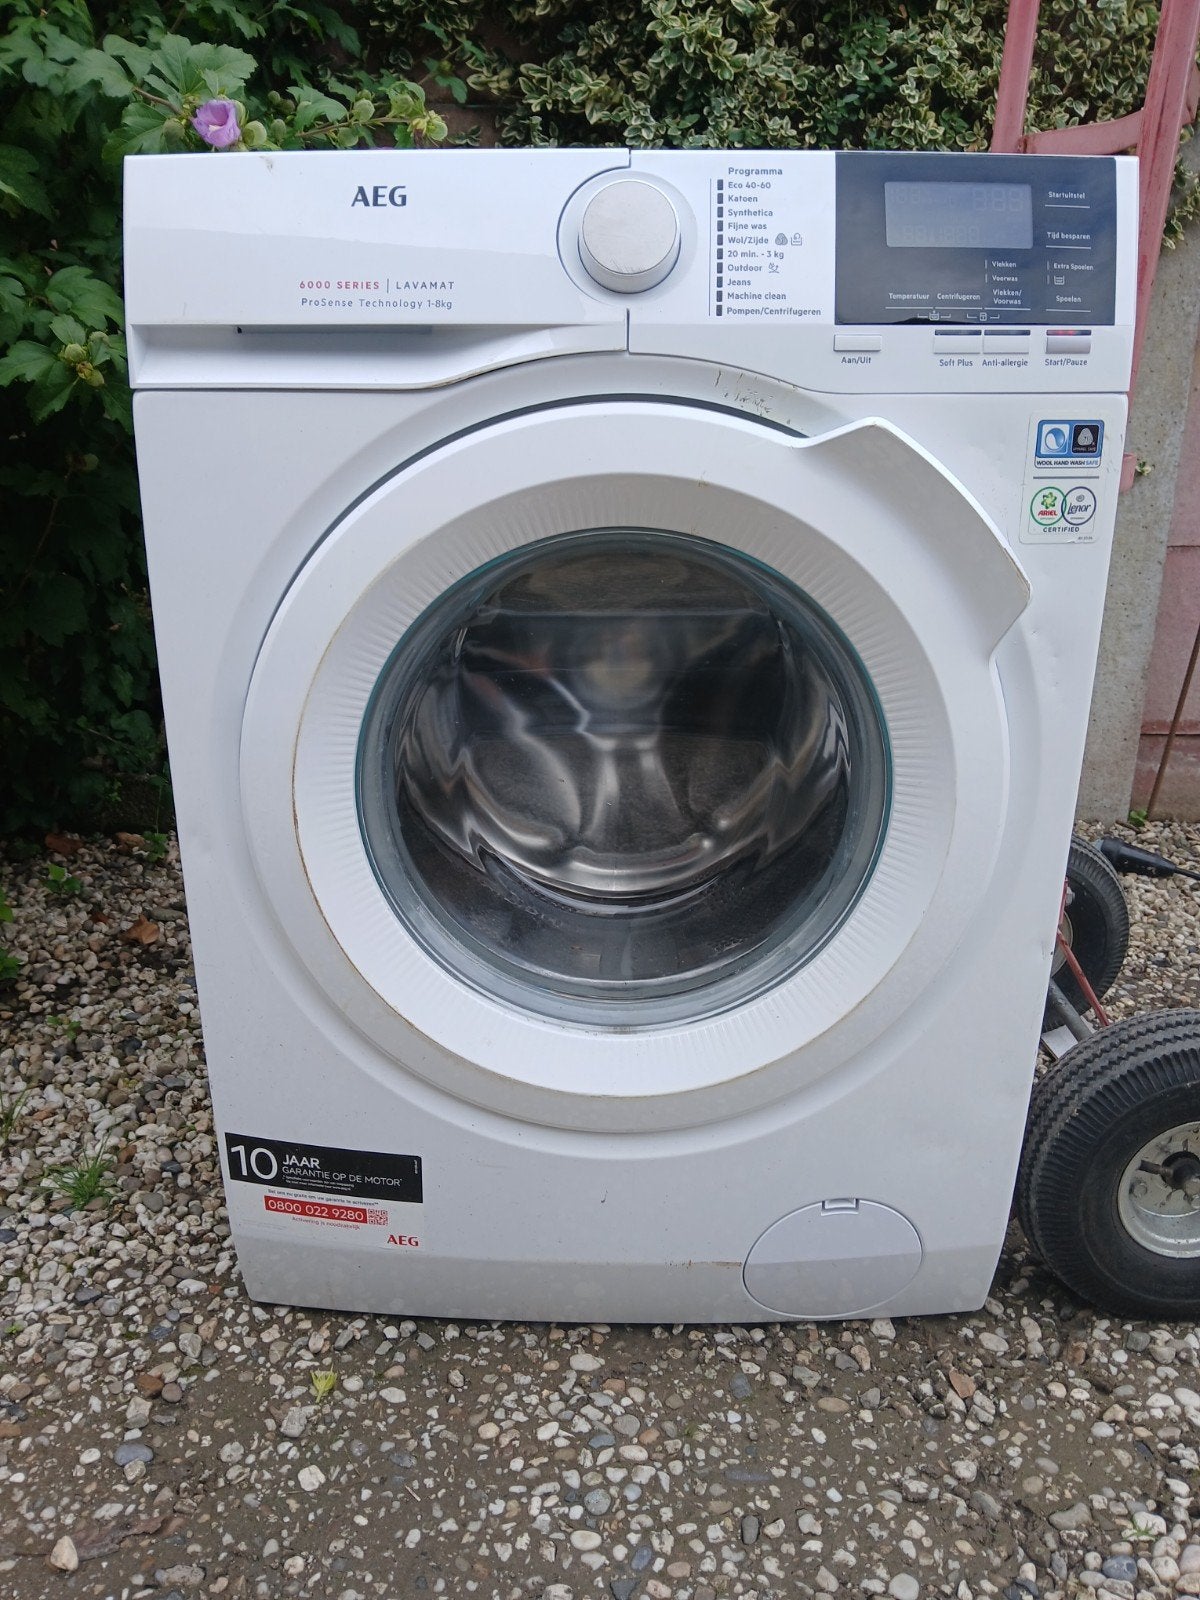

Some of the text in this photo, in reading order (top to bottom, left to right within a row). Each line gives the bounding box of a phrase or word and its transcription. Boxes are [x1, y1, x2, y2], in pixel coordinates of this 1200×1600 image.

[728, 167, 783, 177] Programma
[728, 181, 771, 189] Eco 40-60
[351, 185, 407, 207] AEG
[728, 195, 758, 203] Katoen
[1048, 190, 1086, 199] Startuitstel
[728, 209, 774, 218] Synthetica
[728, 222, 749, 231] Fijne
[728, 236, 769, 246] Wol/Zijde
[1047, 232, 1091, 241] Tijd besparen
[727, 250, 738, 258] 20
[740, 250, 759, 258] min.
[766, 250, 772, 258] 3
[774, 250, 785, 260] kg
[727, 264, 763, 272] Outdoor
[991, 260, 1017, 268] Vlekken
[1053, 262, 1094, 271] Extra Spoelen
[299, 280, 380, 290] 6000 SERIES
[396, 281, 455, 290] LAVAMAT
[727, 278, 752, 286] Jeans
[727, 292, 787, 300] Machine clean
[889, 292, 930, 301] Temperatuur
[937, 292, 981, 301] Centrifugeren
[992, 289, 1022, 297] Vlekken/
[301, 298, 453, 310] ProSense Technology 1-8kg
[993, 297, 1022, 305] Voorwas
[1055, 295, 1082, 304] Spoelen
[727, 307, 821, 317] Pompen/Centrifugeren
[841, 356, 872, 365] Aan/Uit
[939, 358, 973, 367] Soft Plus
[982, 358, 1029, 368] Anti-allergie
[1045, 358, 1088, 367] Start/Pauze
[1067, 502, 1091, 515] Lenor
[230, 1144, 278, 1180] 10
[282, 1154, 321, 1169] JAAR
[282, 1166, 331, 1180] GARANTIE
[332, 1172, 347, 1182] OP
[349, 1174, 362, 1183] DE
[268, 1199, 364, 1221] 0800 022 9280
[292, 1216, 320, 1226] Activering
[387, 1234, 419, 1247] AEG
